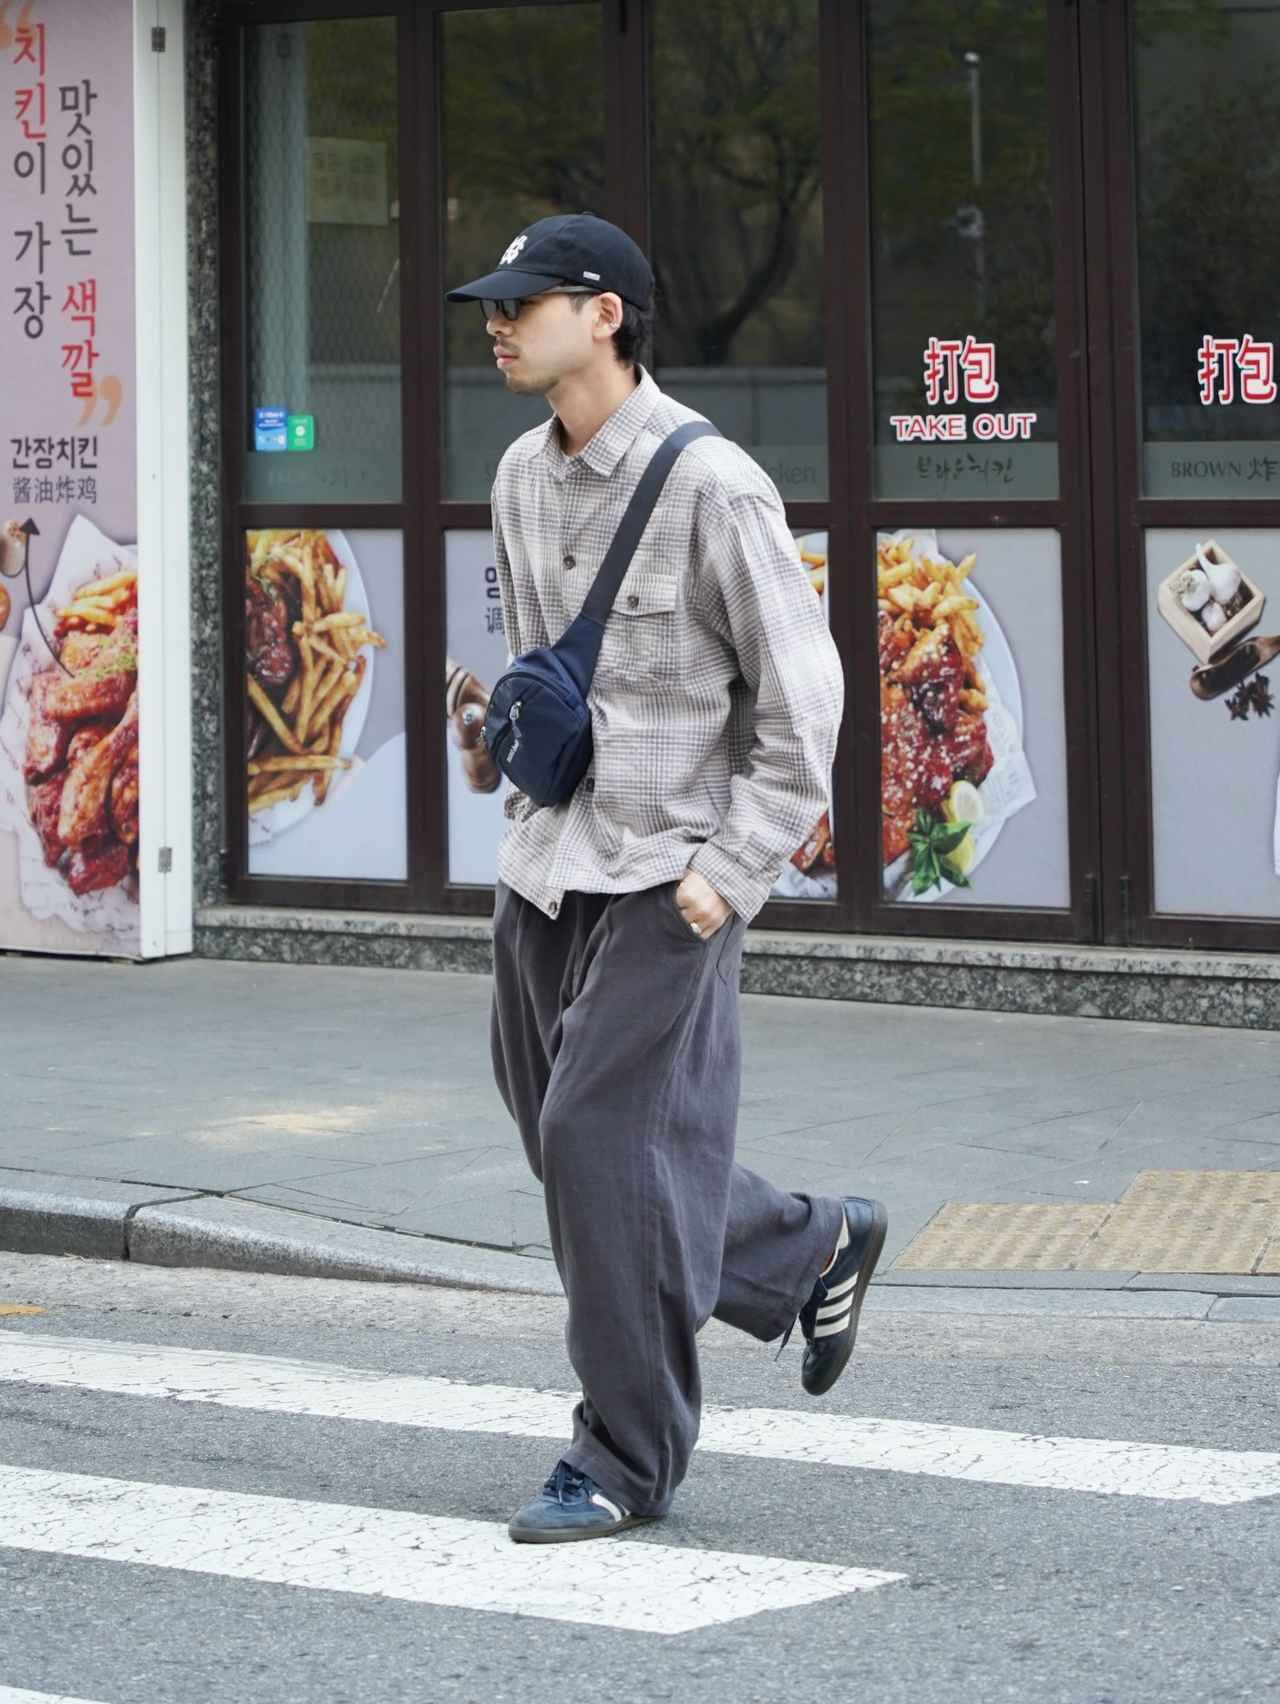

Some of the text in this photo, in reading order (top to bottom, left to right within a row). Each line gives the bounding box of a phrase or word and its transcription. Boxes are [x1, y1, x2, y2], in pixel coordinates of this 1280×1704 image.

[13, 23, 51, 339] 치킨이 가장
[58, 79, 99, 398] 맛있는 색깔
[923, 335, 999, 405] 打包
[1197, 335, 1277, 405] 打包
[10, 436, 98, 469] 간장치킨
[891, 412, 1037, 442] TAKE OUT
[1170, 459, 1242, 479] BROWN
